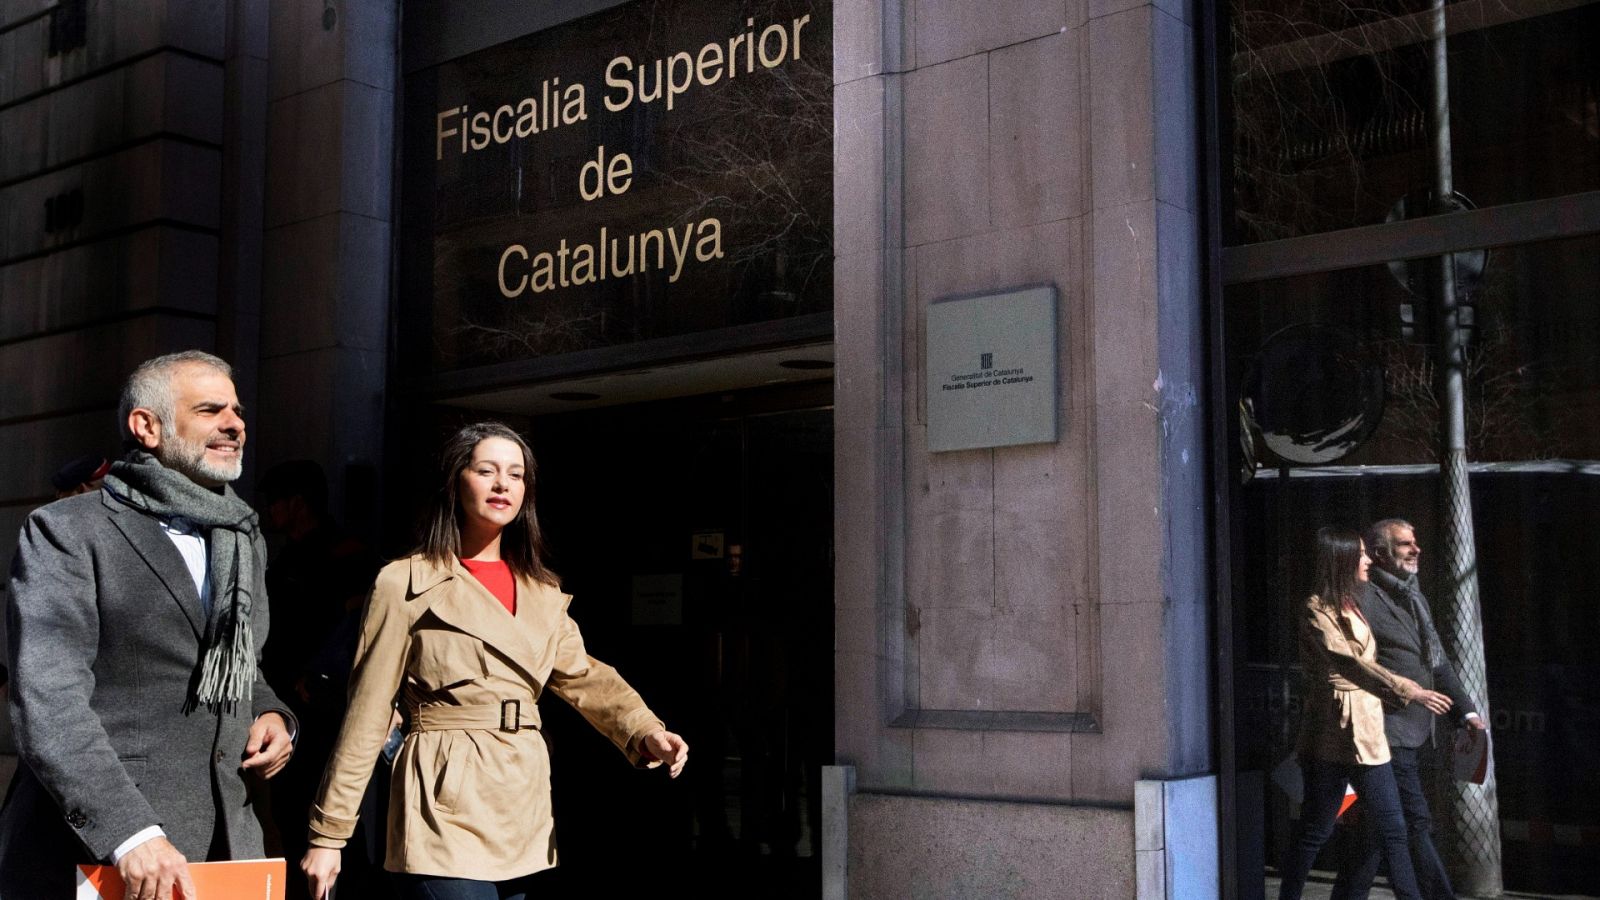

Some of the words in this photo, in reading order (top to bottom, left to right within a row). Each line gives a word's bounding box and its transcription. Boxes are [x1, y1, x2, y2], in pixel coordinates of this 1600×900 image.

[436, 77, 588, 161] Fiscalia
[603, 14, 811, 112] Superior
[579, 145, 634, 201] de
[498, 217, 725, 299] Catalunya
[942, 383, 965, 391] Fiscalia
[966, 379, 991, 390] Superior
[1002, 376, 1033, 385] Catalunya
[951, 372, 983, 382] Generalitat
[983, 370, 992, 378] de
[993, 368, 1024, 377] Catalunya
